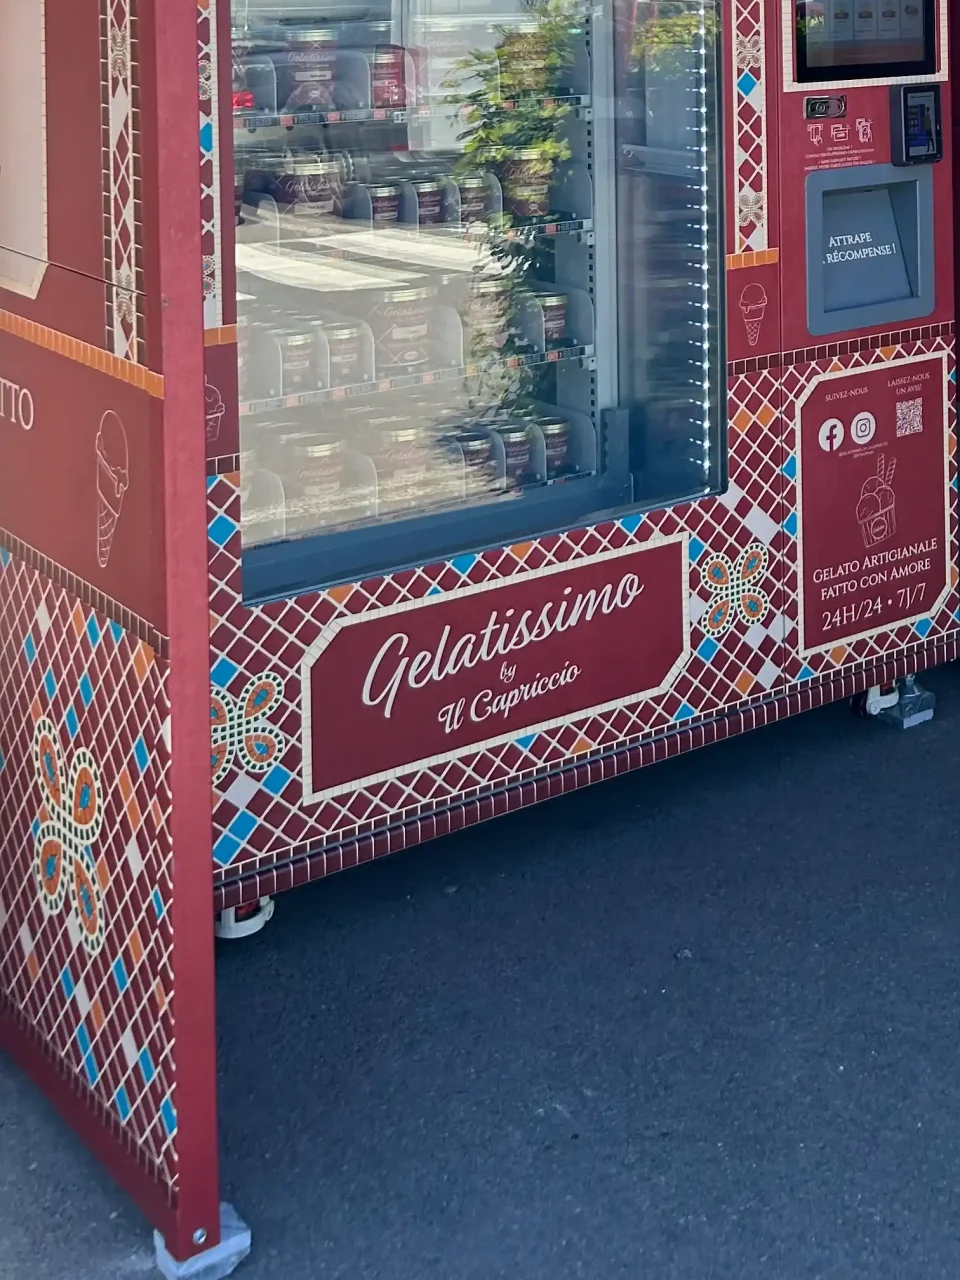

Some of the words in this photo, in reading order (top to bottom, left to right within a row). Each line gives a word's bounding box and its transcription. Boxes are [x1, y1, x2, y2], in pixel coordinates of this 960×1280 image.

[826, 244, 892, 264] RÉCOMPENSE
[828, 232, 873, 248] ATTRAPE
[825, 386, 869, 402] SUIVEZ-NOUS
[813, 559, 860, 583] GELATO
[862, 537, 938, 570] ARTIGIANALE
[820, 580, 859, 601] FATTO
[860, 569, 887, 588] CON
[890, 558, 931, 581] AMORE
[821, 595, 883, 632] 24H/24
[896, 581, 927, 610] 7J/7
[361, 572, 645, 719] Gelatissimo
[469, 661, 582, 723] Capriccio
[499, 661, 518, 684] by
